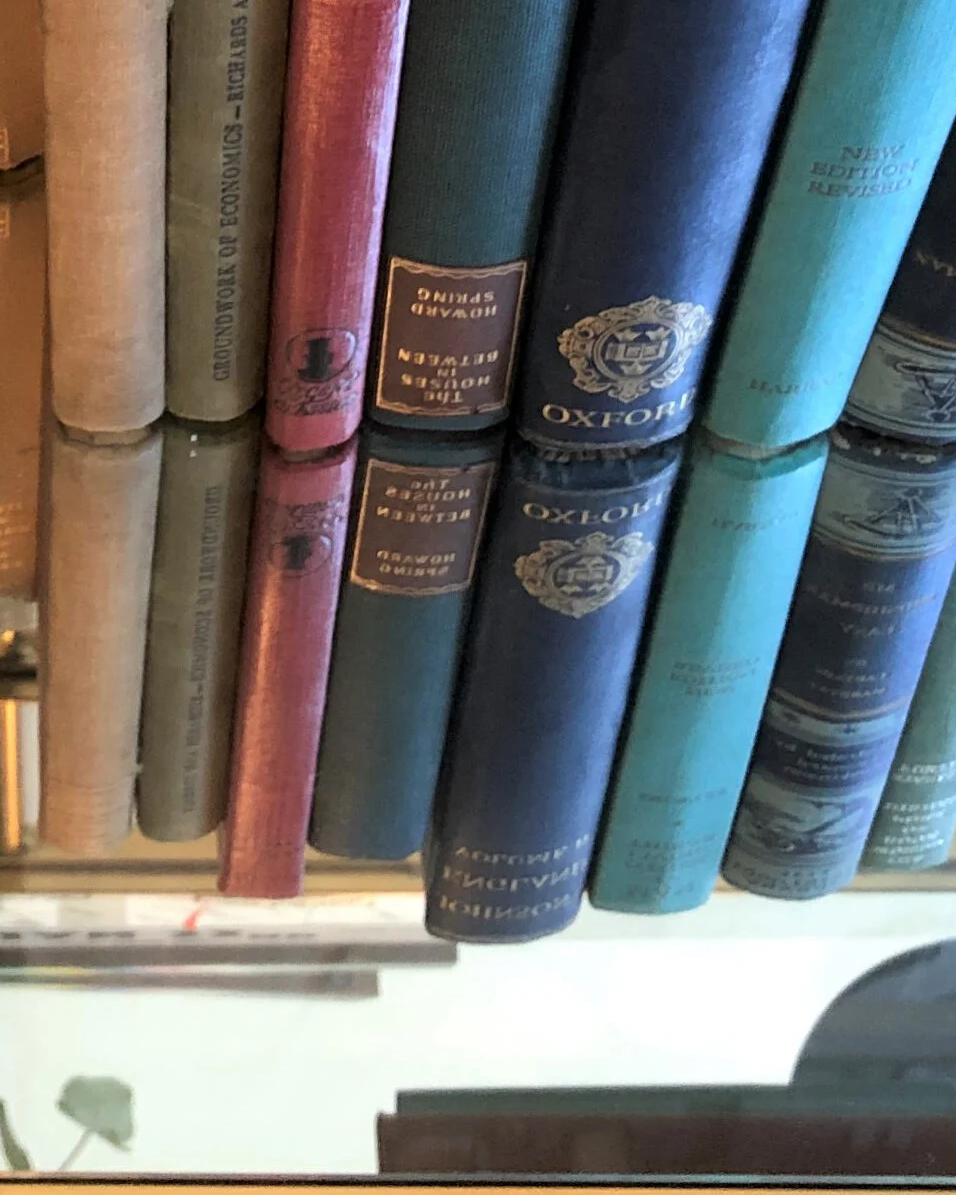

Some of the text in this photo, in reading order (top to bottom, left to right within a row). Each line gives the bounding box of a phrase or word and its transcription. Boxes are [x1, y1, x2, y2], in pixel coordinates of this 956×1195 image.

[227, 16, 249, 104] RICHARDS
[841, 144, 906, 162] NEW
[220, 124, 244, 228] ECONOMICS
[810, 158, 920, 180] EDITION
[218, 235, 237, 257] OF
[417, 287, 495, 304] SPRING
[410, 302, 498, 319] HOWARD
[212, 263, 237, 382] GROUNDWORK
[398, 347, 499, 367] BETWEEN
[400, 373, 491, 389] HOUSES
[437, 367, 457, 378] IN
[423, 390, 464, 406] The
